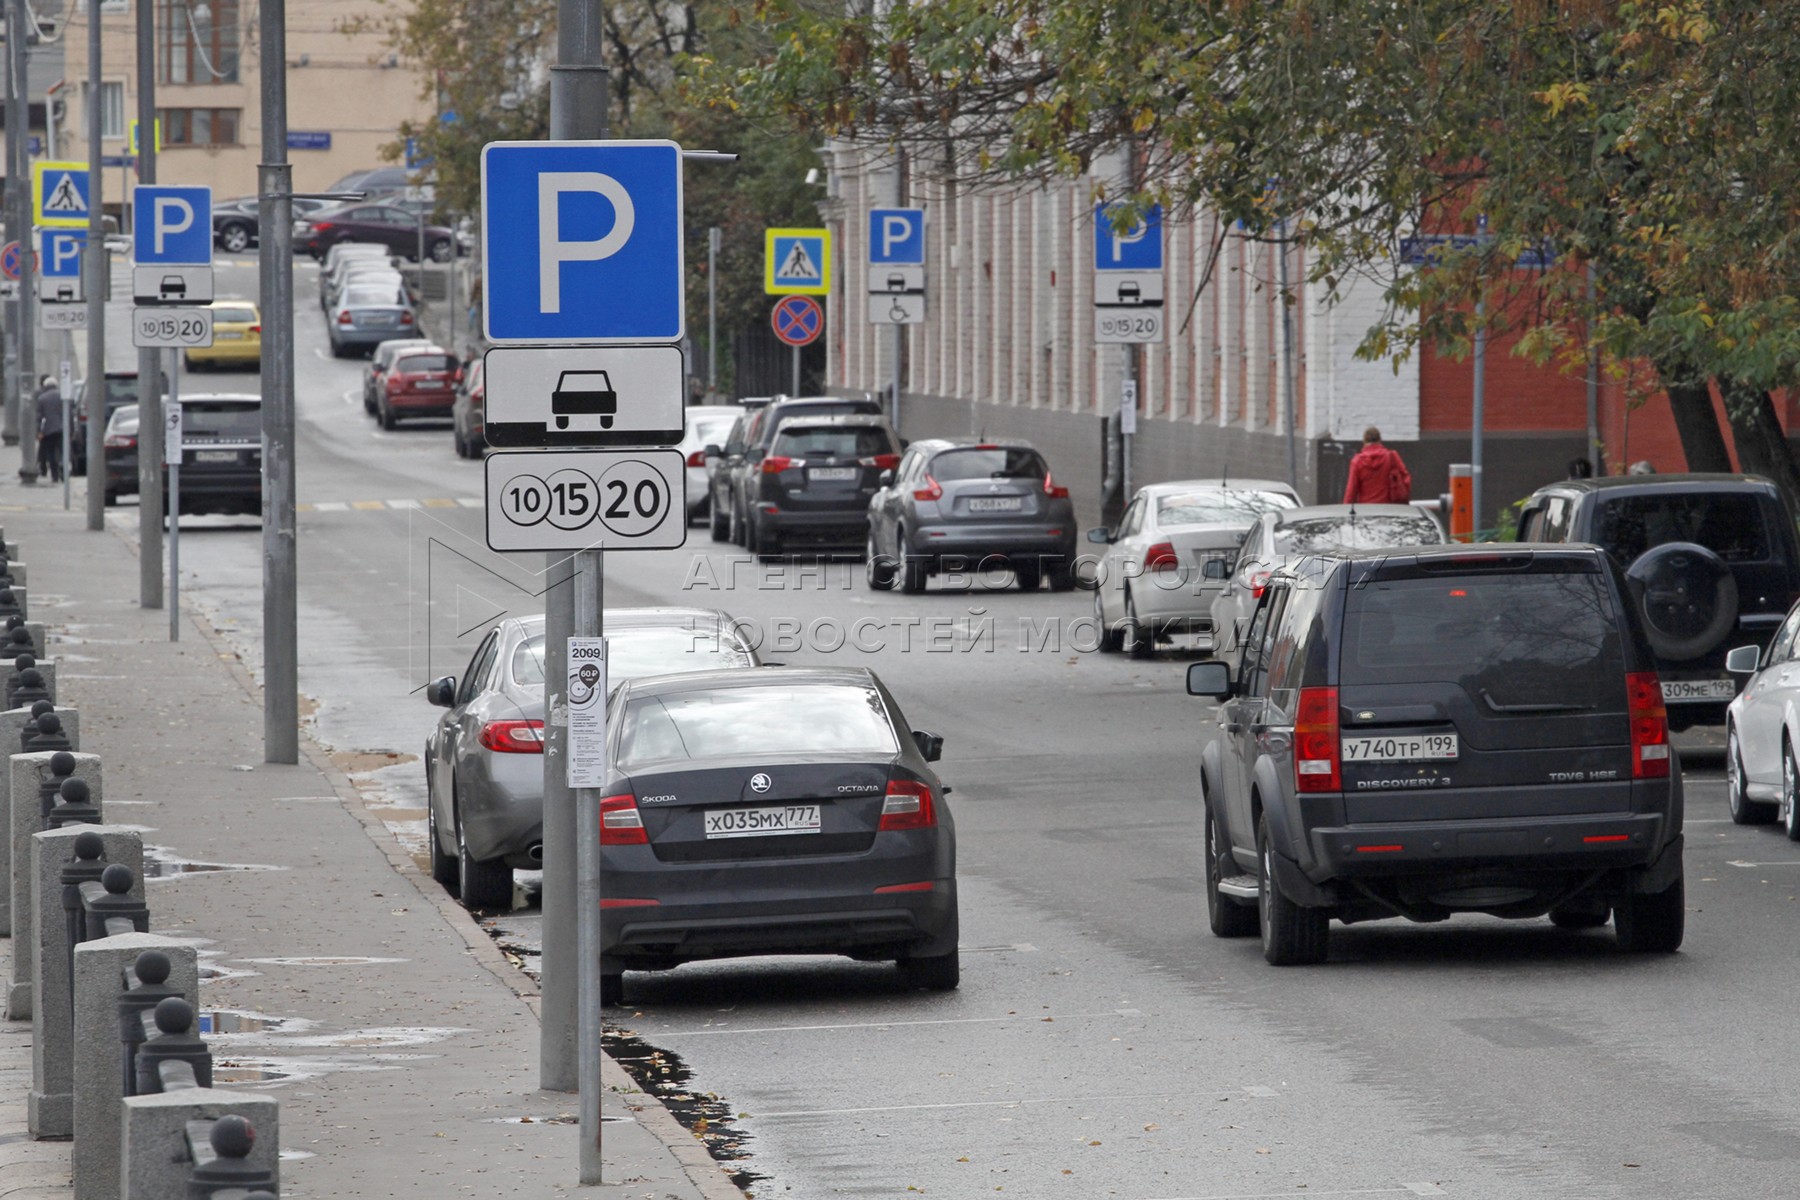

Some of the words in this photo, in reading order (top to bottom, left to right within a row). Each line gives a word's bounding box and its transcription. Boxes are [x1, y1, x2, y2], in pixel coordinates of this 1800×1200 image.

[154, 197, 194, 254] P
[883, 216, 912, 257] P
[538, 171, 635, 313] P
[53, 235, 79, 272] P
[143, 322, 156, 333] 10
[160, 320, 175, 335] 15
[181, 320, 203, 336] 20
[1117, 320, 1130, 332] 15
[1135, 319, 1155, 333] 20
[510, 487, 541, 513] 10
[552, 483, 589, 516] 15
[605, 479, 660, 519] 20
[572, 648, 600, 659] 2009
[1663, 683, 1708, 697] 309МЕ
[1712, 681, 1731, 691] 199
[1348, 739, 1420, 758] У740ТР
[1425, 736, 1452, 751] 199
[1357, 778, 1436, 789] DISCOVERY
[1441, 777, 1451, 785] 3
[1589, 770, 1617, 779] HSE
[711, 810, 784, 831] Х035МХ
[787, 807, 815, 821] 777
